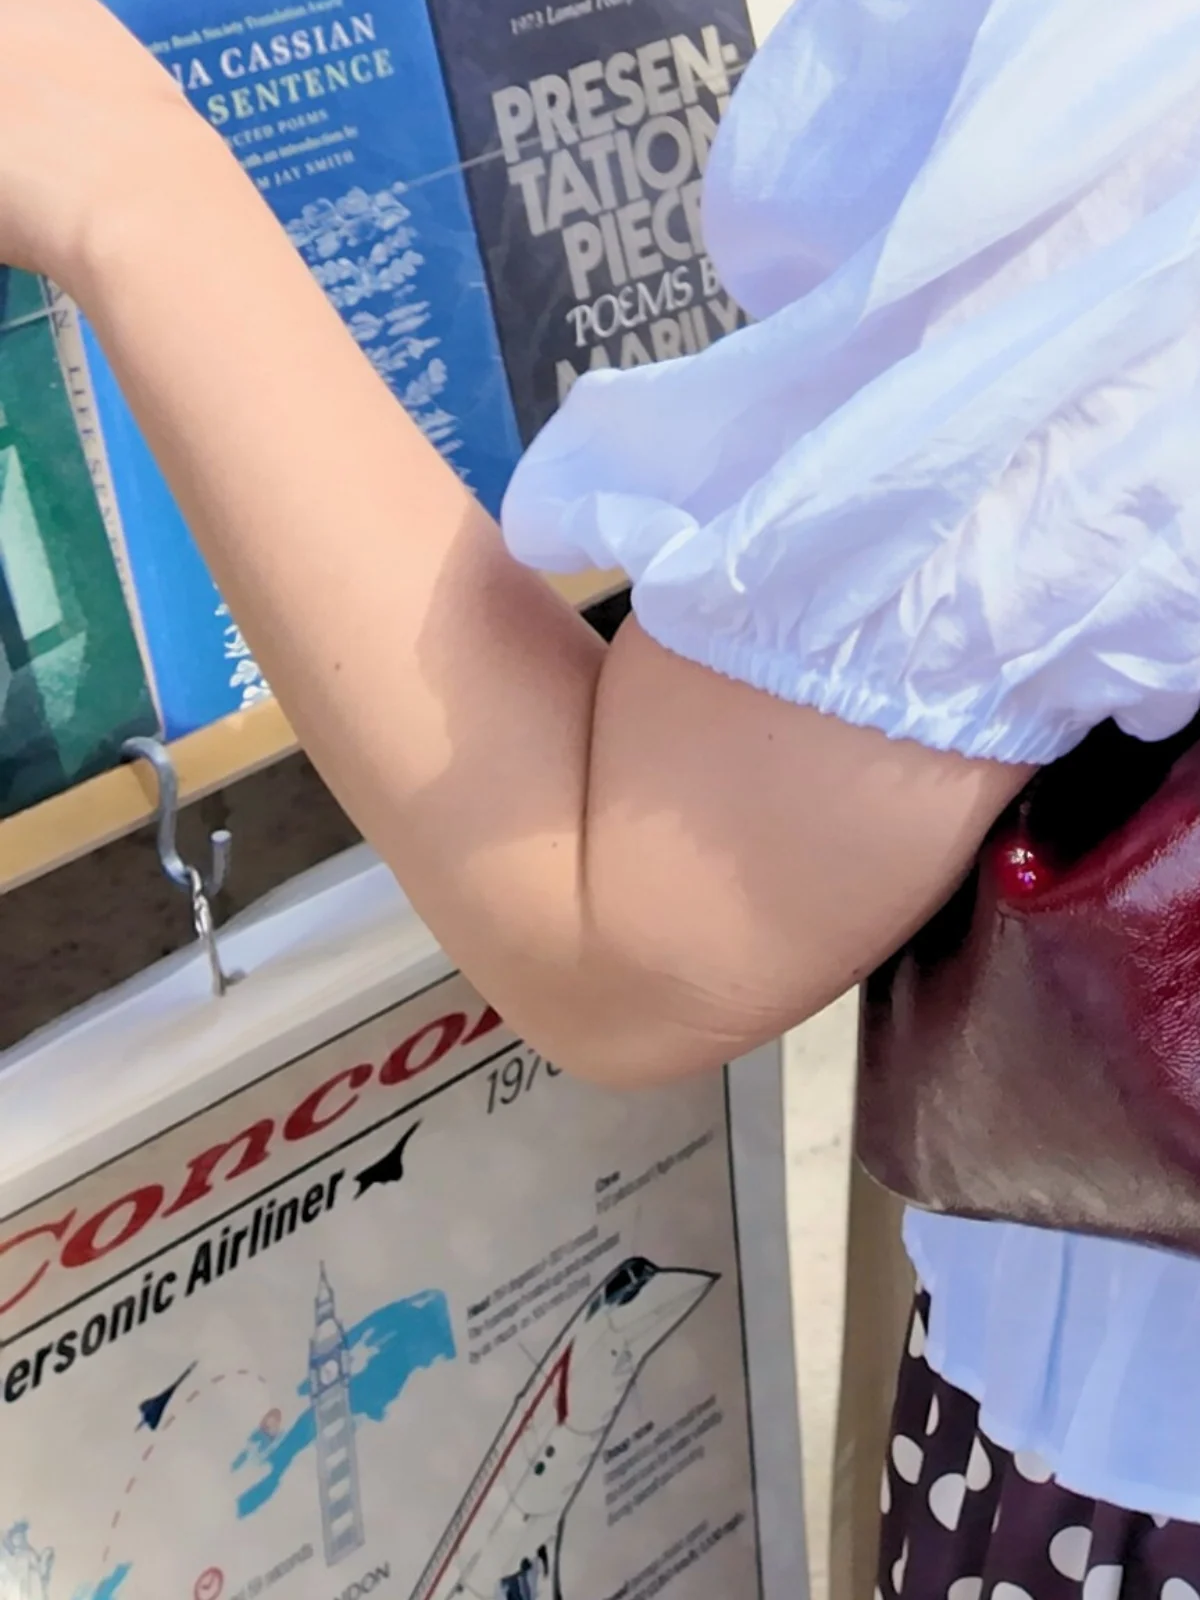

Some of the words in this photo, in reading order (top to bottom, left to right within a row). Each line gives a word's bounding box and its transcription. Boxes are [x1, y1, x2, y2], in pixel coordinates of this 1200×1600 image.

[219, 12, 377, 80] CASSIAN
[206, 48, 395, 126] SENTENCE
[277, 108, 328, 135] POEMS
[491, 24, 739, 164] PRESEN-
[303, 148, 355, 176] SMITH
[565, 265, 694, 347] POEMS
[3, 1270, 178, 1404] ersonic
[184, 1169, 346, 1298] Airliner
